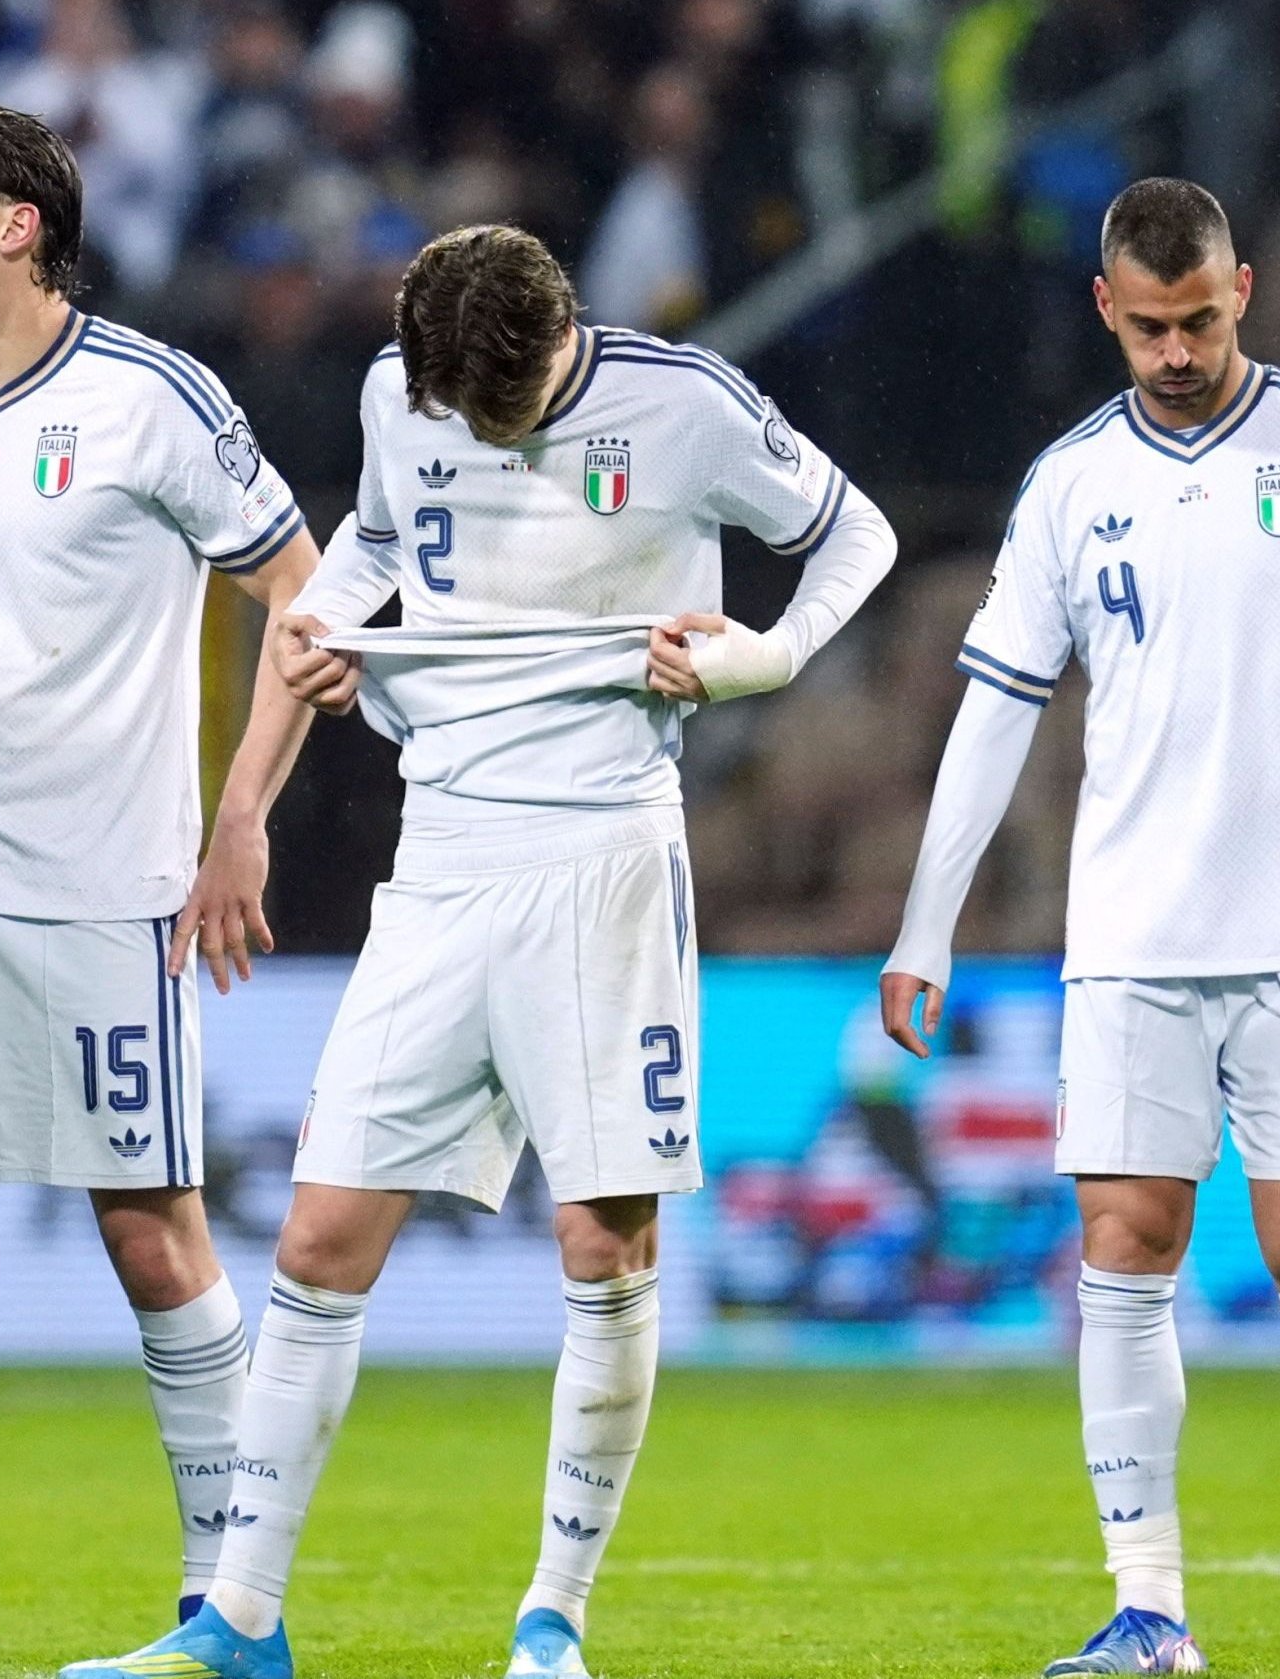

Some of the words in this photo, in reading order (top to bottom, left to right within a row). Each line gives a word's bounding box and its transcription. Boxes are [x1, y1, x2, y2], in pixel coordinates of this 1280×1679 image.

[40, 439, 72, 451] ITALIA
[588, 454, 625, 467] ITALIA
[415, 506, 457, 595] 2
[1097, 561, 1147, 645] 4
[75, 1024, 152, 1115] 15
[640, 1023, 688, 1116] 2
[178, 1460, 235, 1476] ITALI
[558, 1460, 615, 1490] ITALIA
[1087, 1456, 1139, 1476] TALIA
